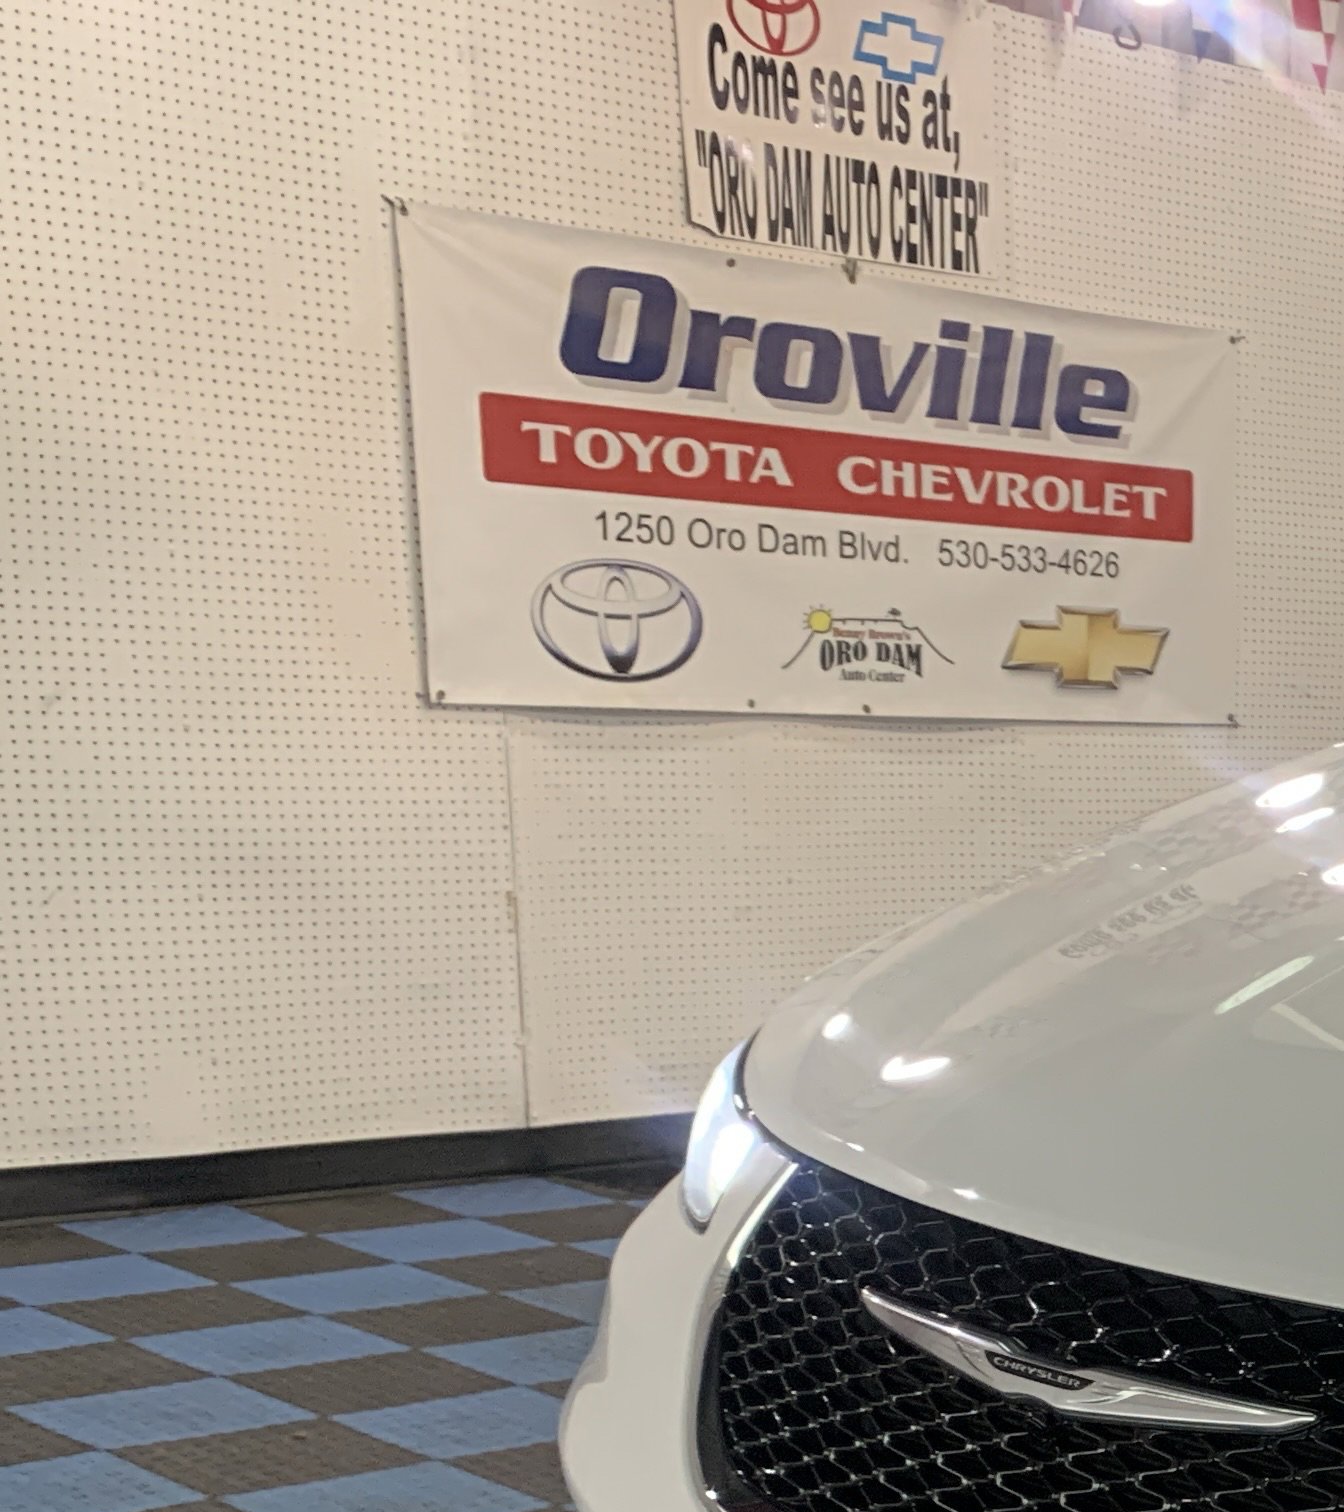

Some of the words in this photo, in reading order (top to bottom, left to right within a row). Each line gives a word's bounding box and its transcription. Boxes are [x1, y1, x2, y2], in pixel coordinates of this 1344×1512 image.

[707, 22, 800, 124] Come
[810, 67, 865, 136] see
[876, 80, 911, 145] us
[922, 75, 960, 172] at,
[764, 142, 814, 249] DAM
[821, 153, 882, 260] AUTO
[890, 165, 989, 274] CENTER"
[560, 265, 1134, 442] Oroville
[520, 420, 794, 487] TOYOTA
[837, 456, 1167, 521] CHEVROLET
[595, 510, 675, 546] 1250
[688, 518, 745, 551] Oro
[758, 523, 827, 558] Dam
[839, 530, 909, 564] Blvd.
[938, 538, 1120, 578] 530-533-4626
[820, 639, 868, 671] ORO
[875, 641, 923, 678] DAM
[839, 668, 866, 681] Auto
[868, 669, 906, 683] Center
[993, 1356, 1081, 1388] CHRYSLER
